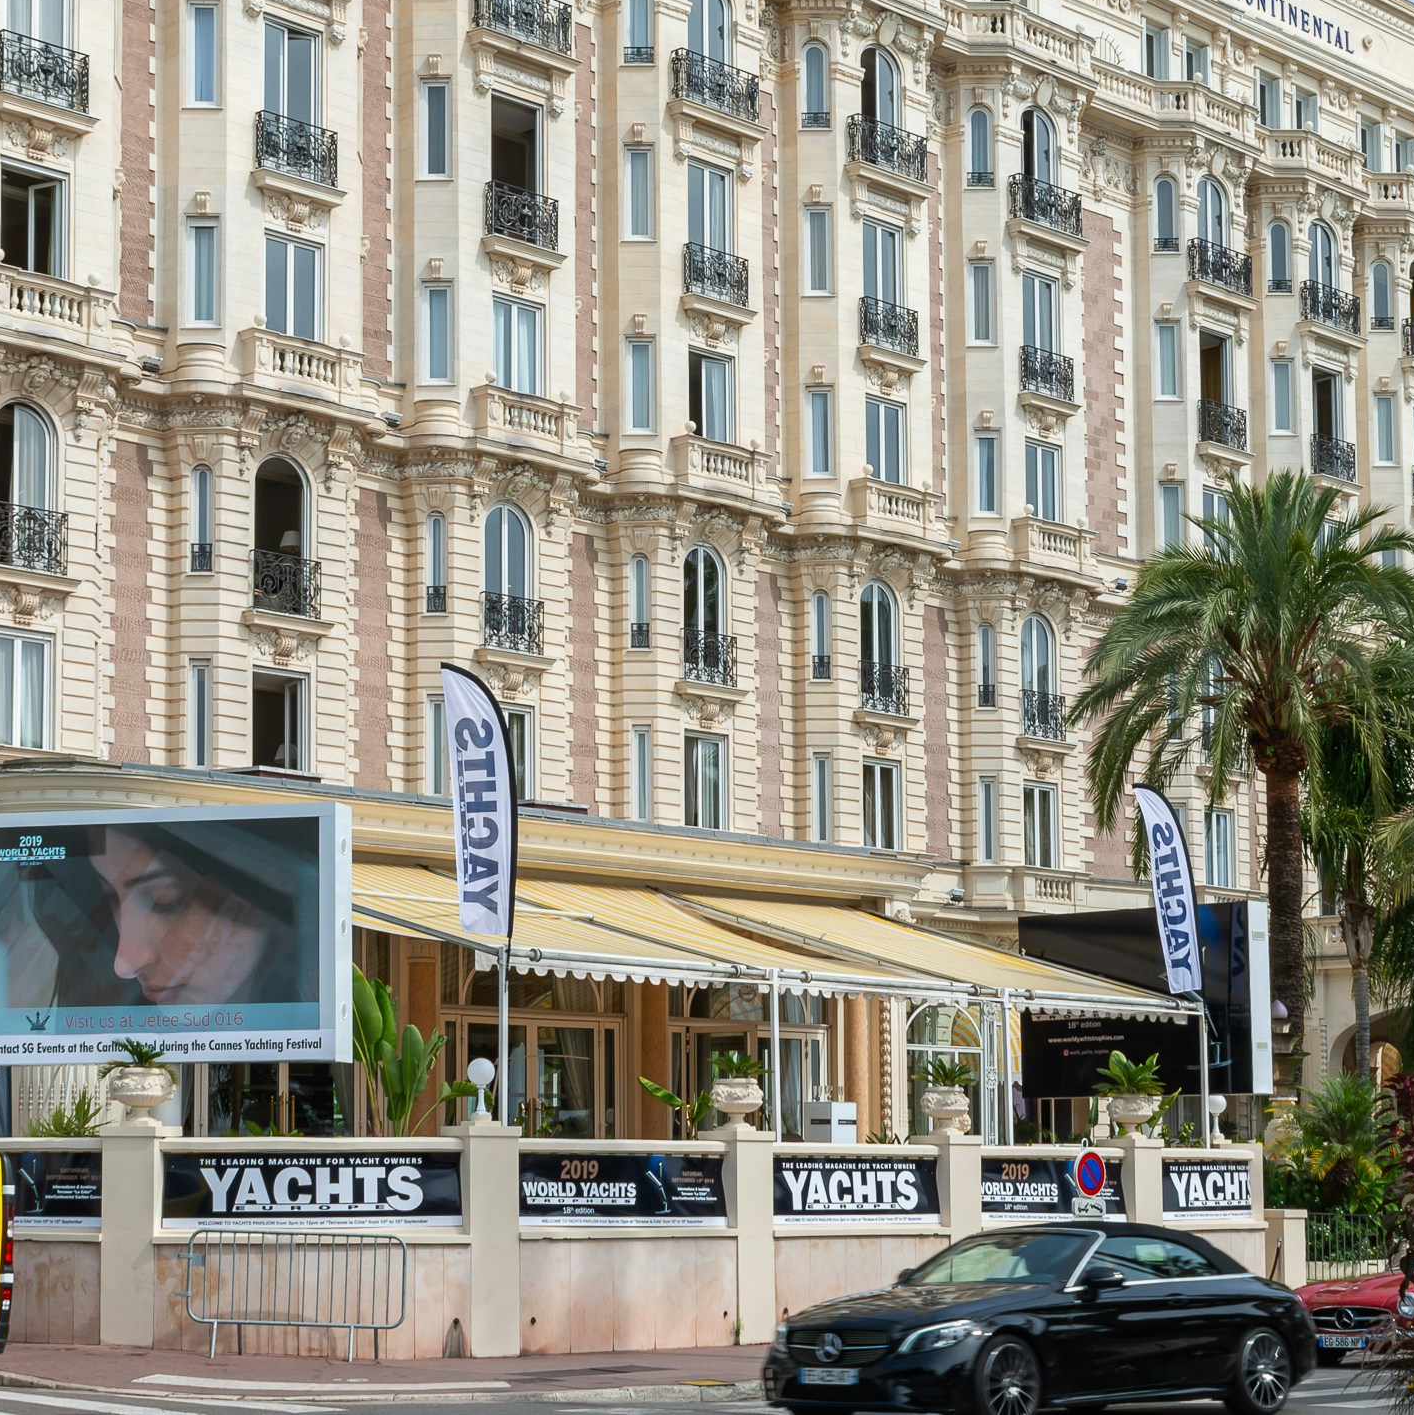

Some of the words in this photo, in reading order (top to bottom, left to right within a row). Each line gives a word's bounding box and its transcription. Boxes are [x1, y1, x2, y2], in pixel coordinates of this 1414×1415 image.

[19, 835, 43, 847] 2019
[31, 847, 66, 856] YACHTS
[64, 1014, 94, 1029] Visit
[99, 1017, 115, 1028] us
[119, 1016, 133, 1028] at
[138, 1013, 179, 1028] Jetee
[183, 1012, 210, 1027] Sud
[214, 1011, 244, 1026] 016
[22, 1042, 34, 1054] SG
[37, 1042, 65, 1053] Events
[68, 1042, 77, 1053] at
[79, 1041, 94, 1052] the
[159, 1039, 189, 1054] during
[191, 1039, 206, 1051] the
[209, 1039, 242, 1051] Cannes
[244, 1038, 284, 1052] Yachting
[286, 1037, 322, 1049] Festival
[199, 1158, 217, 1166] THE
[221, 1158, 264, 1166] LEADING
[384, 1157, 423, 1165] OWNERS
[560, 1160, 599, 1179] 2019
[1001, 1163, 1029, 1180] 2019
[199, 1166, 424, 1213] YACHTS
[522, 1181, 577, 1197] WORLD
[580, 1182, 637, 1197] YACHTS
[782, 1170, 919, 1210] YACHTS
[1015, 1182, 1058, 1196] YACHTS
